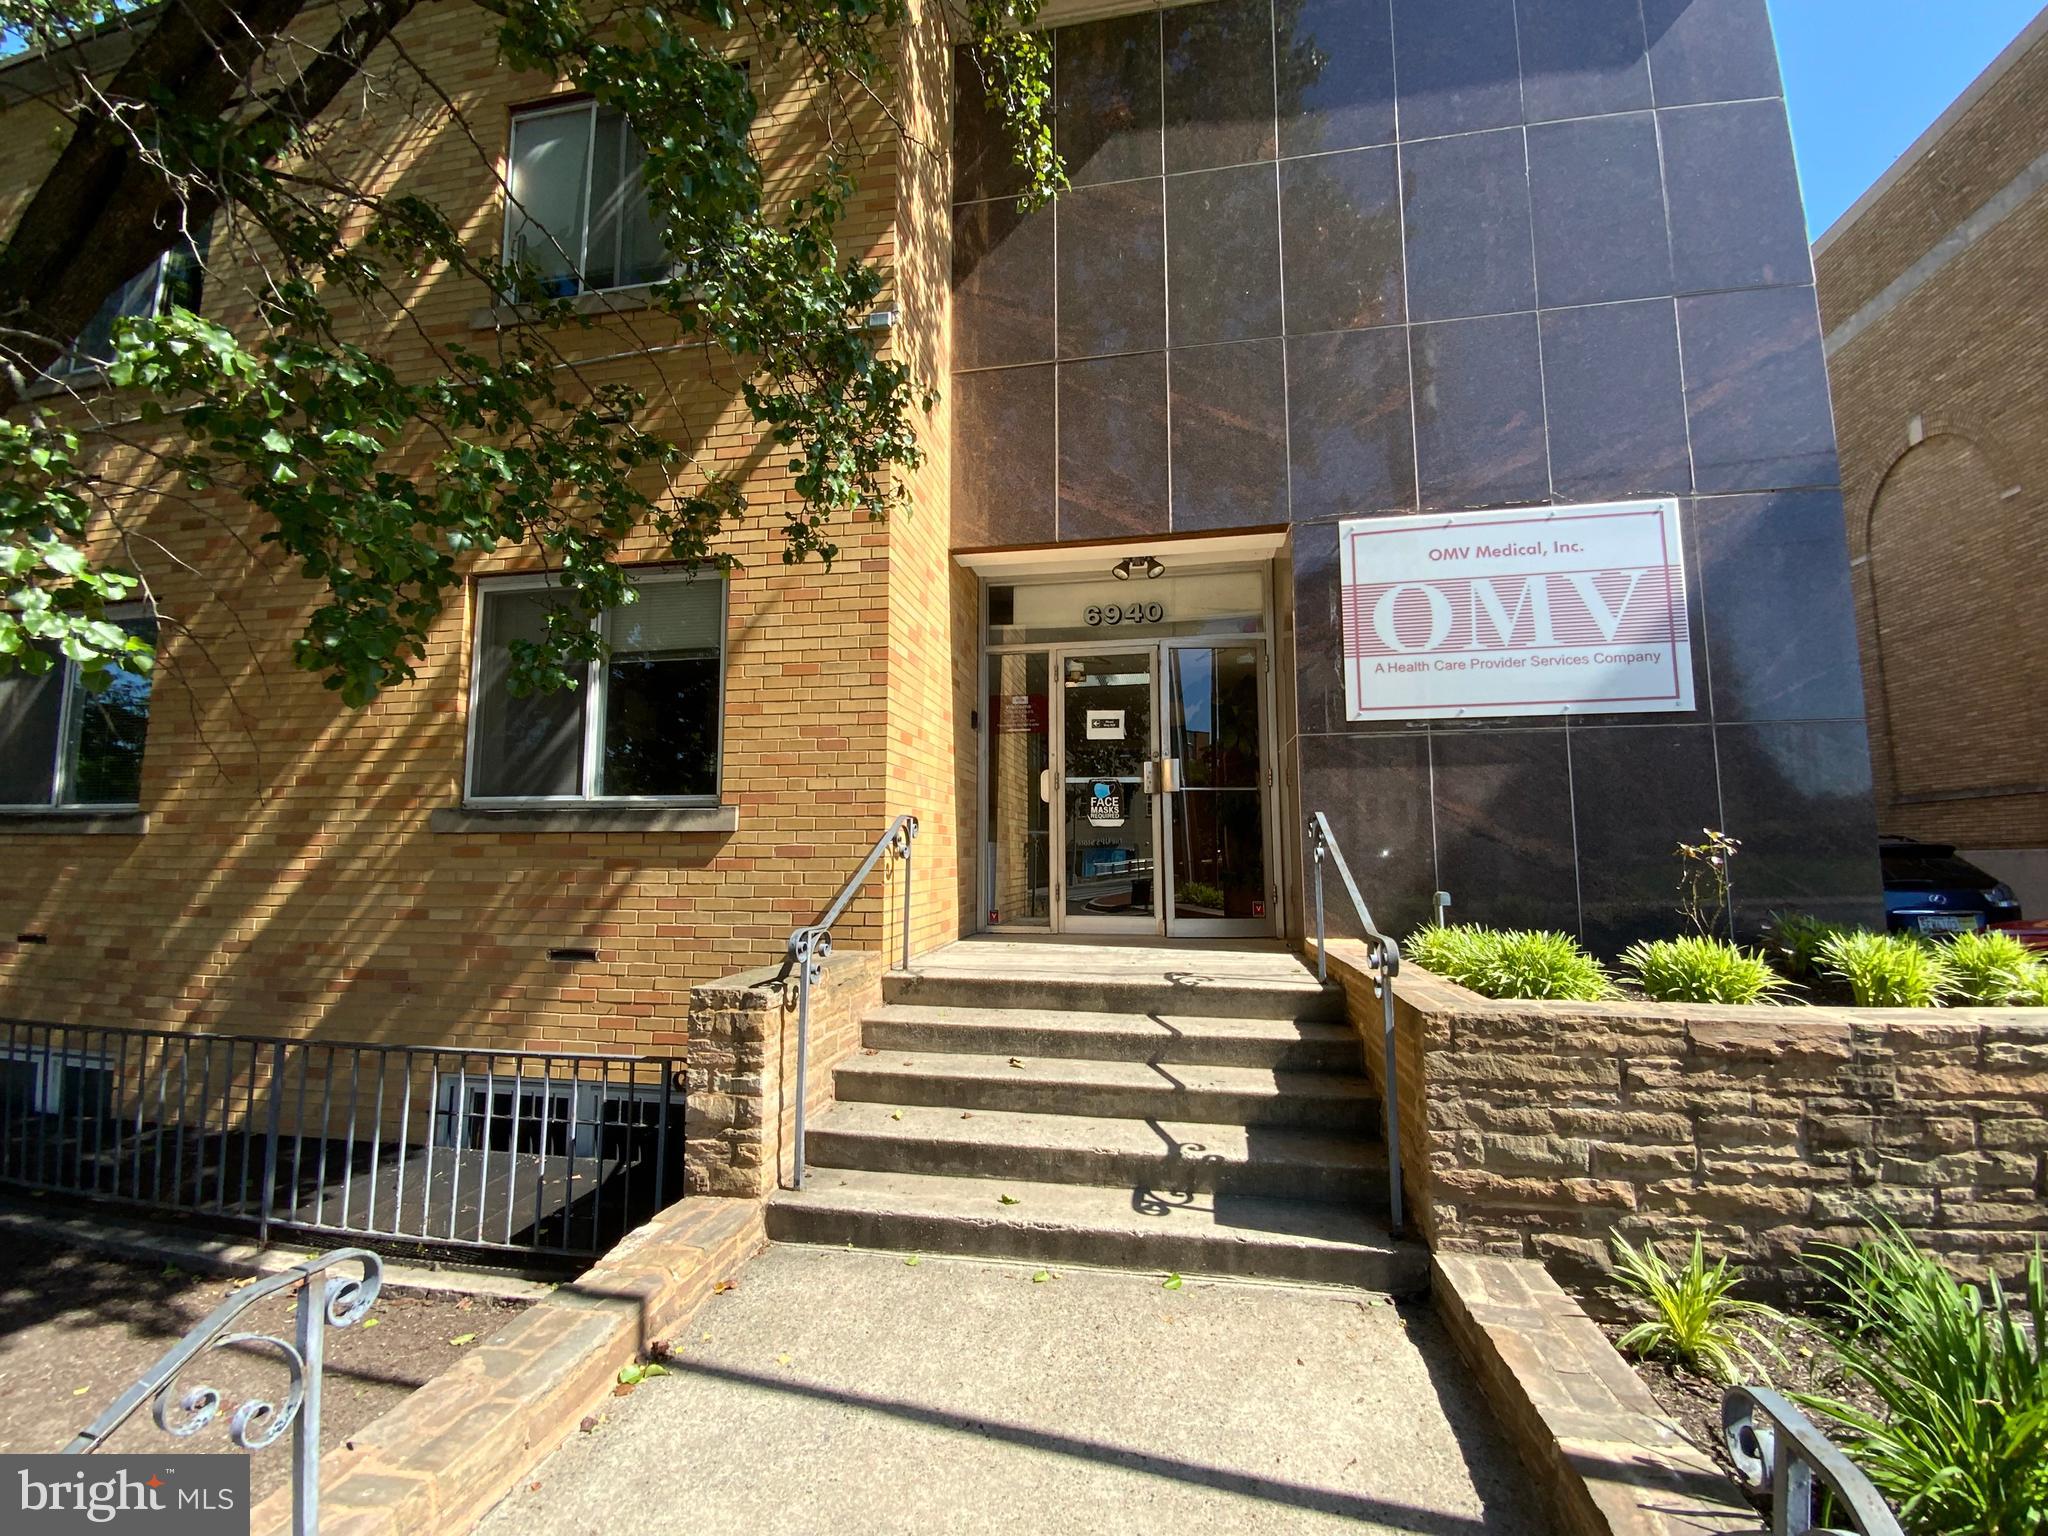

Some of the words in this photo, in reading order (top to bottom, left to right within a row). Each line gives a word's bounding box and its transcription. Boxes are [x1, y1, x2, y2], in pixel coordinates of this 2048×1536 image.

[1428, 547, 1470, 561] OMV
[1476, 542, 1548, 558] Medical,
[1554, 541, 1584, 553] Inc.
[1083, 602, 1164, 626] 6940
[1373, 570, 1649, 652] OMV
[1375, 663, 1385, 673] A
[1387, 661, 1430, 673] Health
[1434, 660, 1466, 671] Care
[1470, 657, 1526, 669] Provider
[1530, 654, 1590, 667] Services
[1593, 652, 1661, 665] Company
[1090, 797, 1119, 807] FACE
